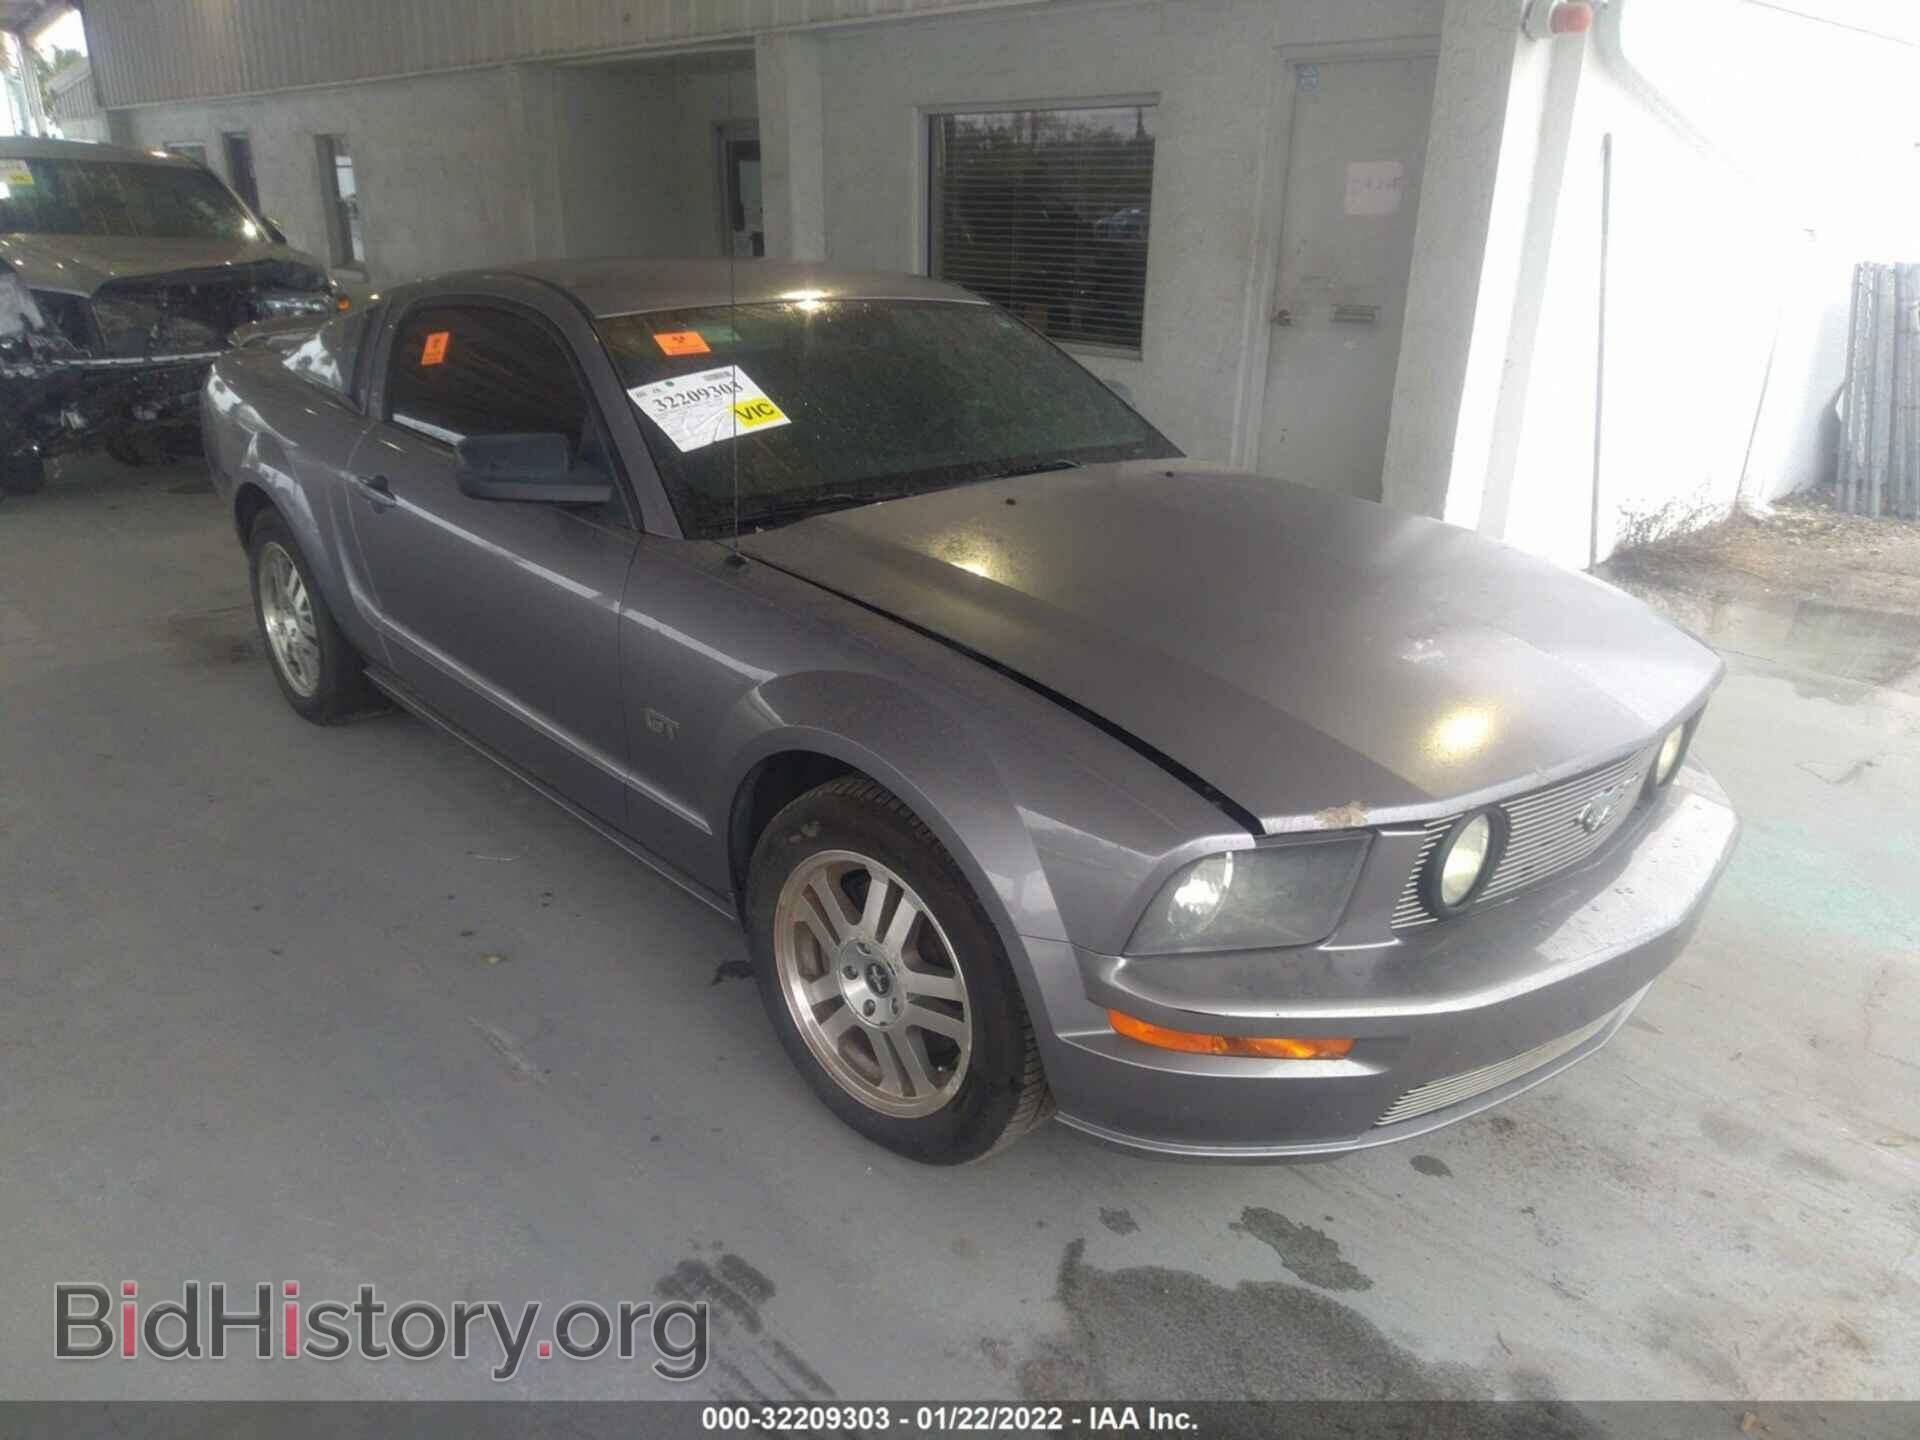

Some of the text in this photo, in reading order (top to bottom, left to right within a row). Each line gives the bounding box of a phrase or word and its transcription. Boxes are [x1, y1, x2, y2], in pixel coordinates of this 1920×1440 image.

[652, 380, 743, 412] 32209303
[734, 402, 775, 420] VIC
[645, 706, 681, 741] GT
